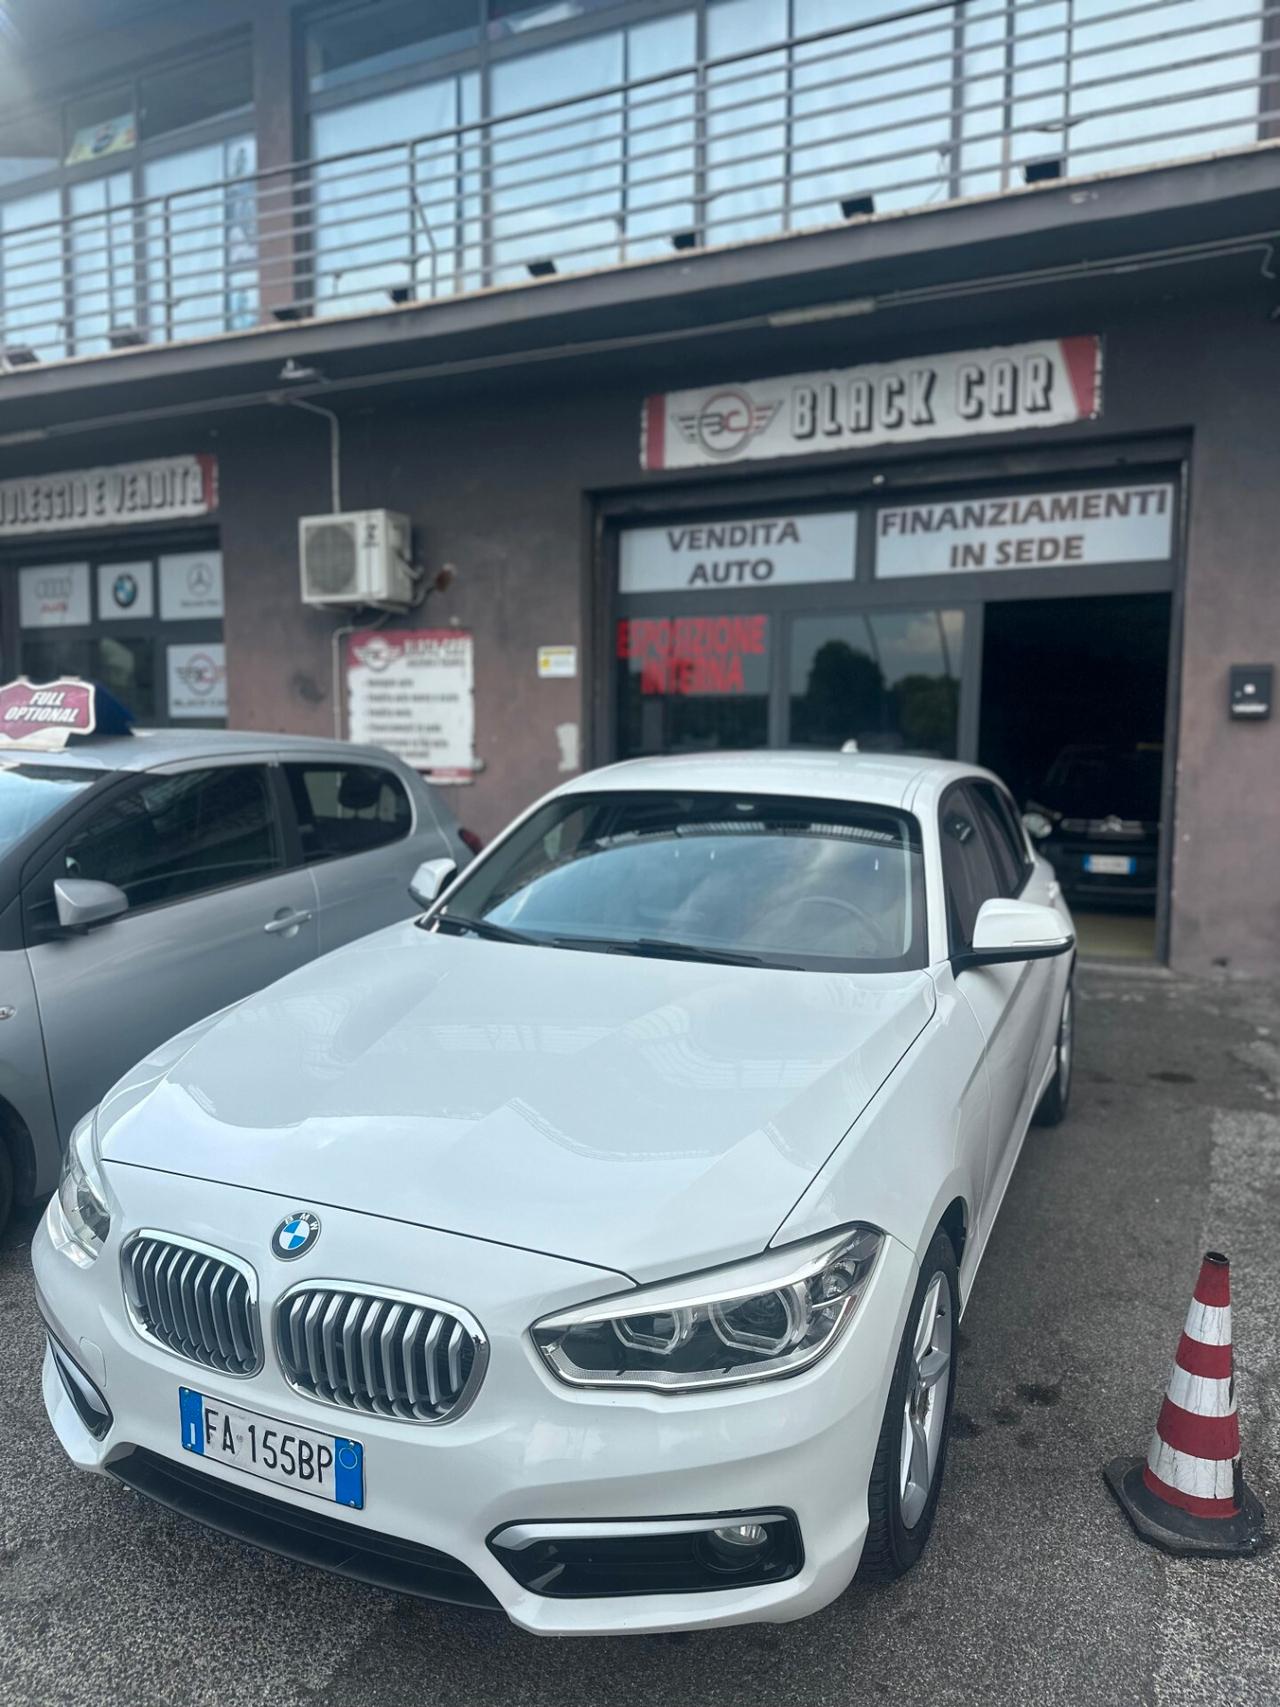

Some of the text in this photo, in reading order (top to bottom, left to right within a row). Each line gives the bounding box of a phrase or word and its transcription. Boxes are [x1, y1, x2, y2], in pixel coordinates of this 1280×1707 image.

[791, 355, 1053, 440] BLACK CAR
[0, 480, 88, 526] OLEGGIO
[110, 466, 205, 514] VENDITA
[880, 489, 1168, 536] FINANZIAMENTI
[667, 520, 801, 552] VENDITA
[950, 536, 1084, 568] IN SEDE
[688, 558, 775, 585] AUTO
[617, 614, 768, 659] ESPOSIZIONE
[640, 655, 744, 695] INTERNA
[4, 705, 80, 723] OPTIONAL
[29, 691, 66, 707] FULL
[284, 1212, 319, 1231] BMW
